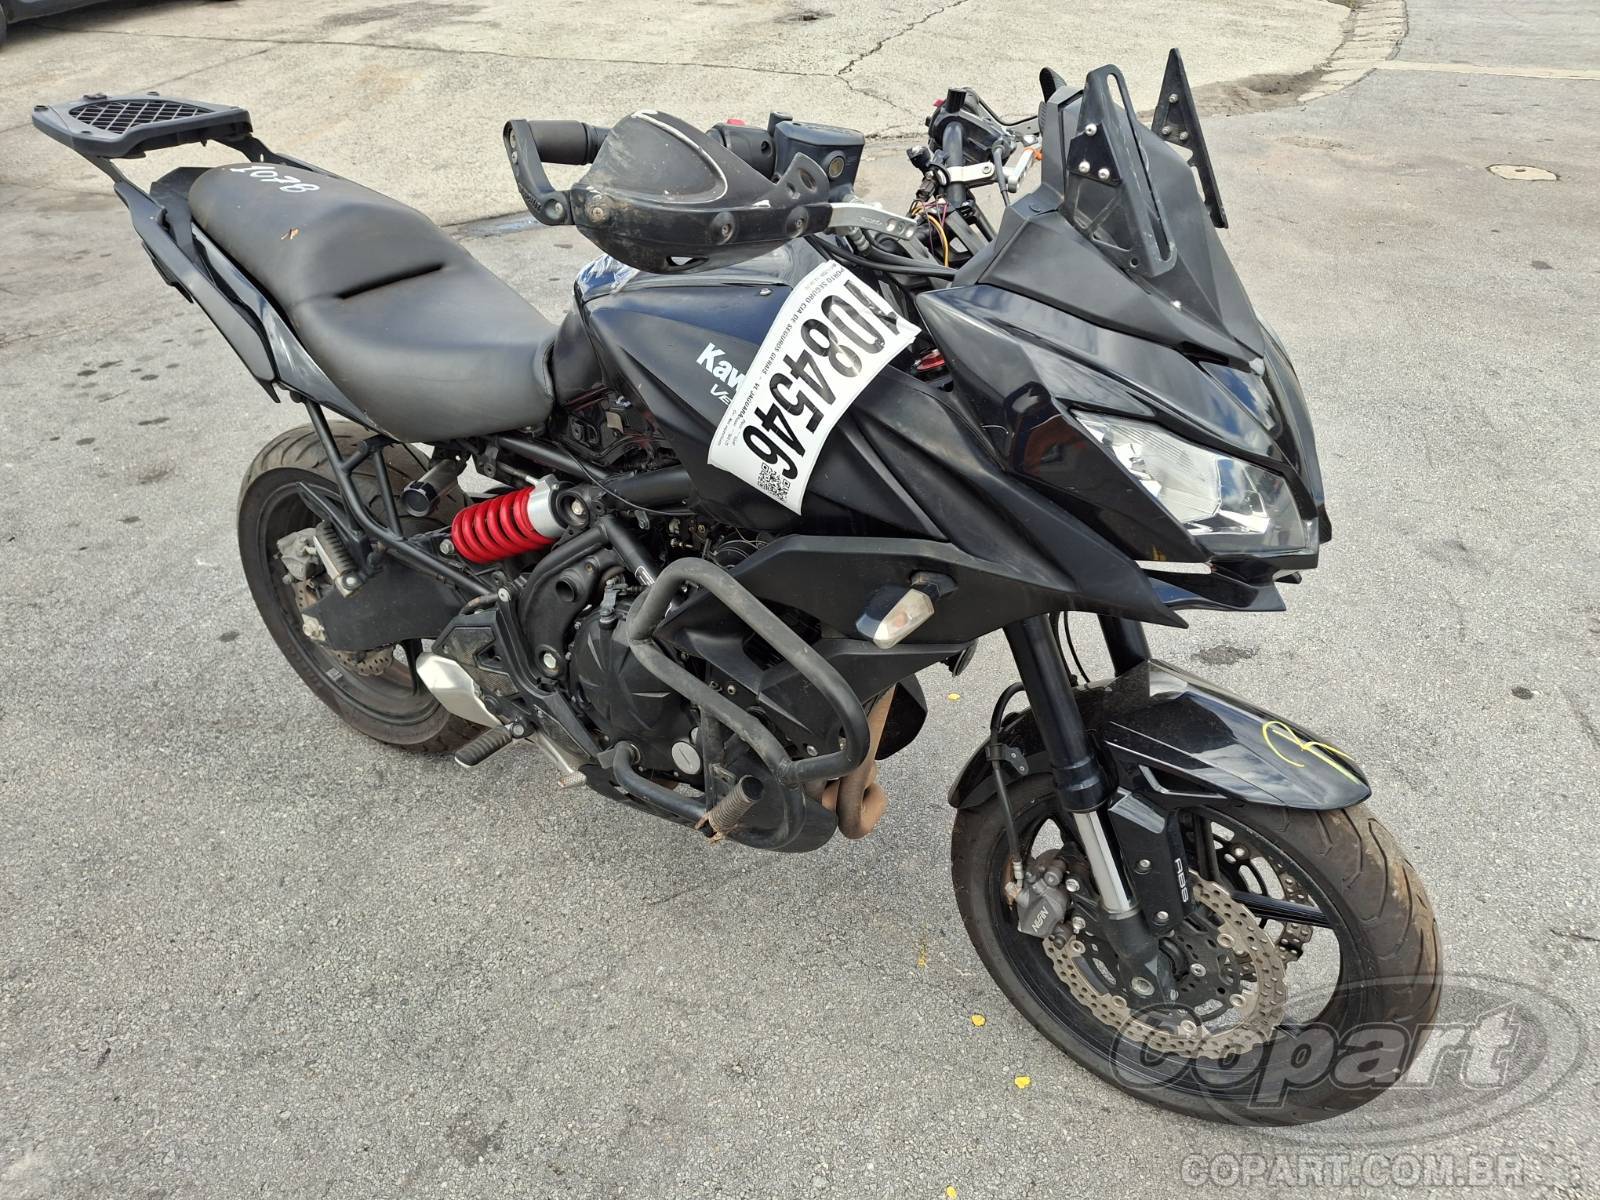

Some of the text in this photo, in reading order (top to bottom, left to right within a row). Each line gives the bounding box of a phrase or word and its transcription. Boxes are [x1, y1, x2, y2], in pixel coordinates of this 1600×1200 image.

[805, 281, 828, 304] SEGURO
[775, 323, 793, 353] SEGUROS
[742, 280, 900, 480] 1084546
[1173, 857, 1189, 903] ABS
